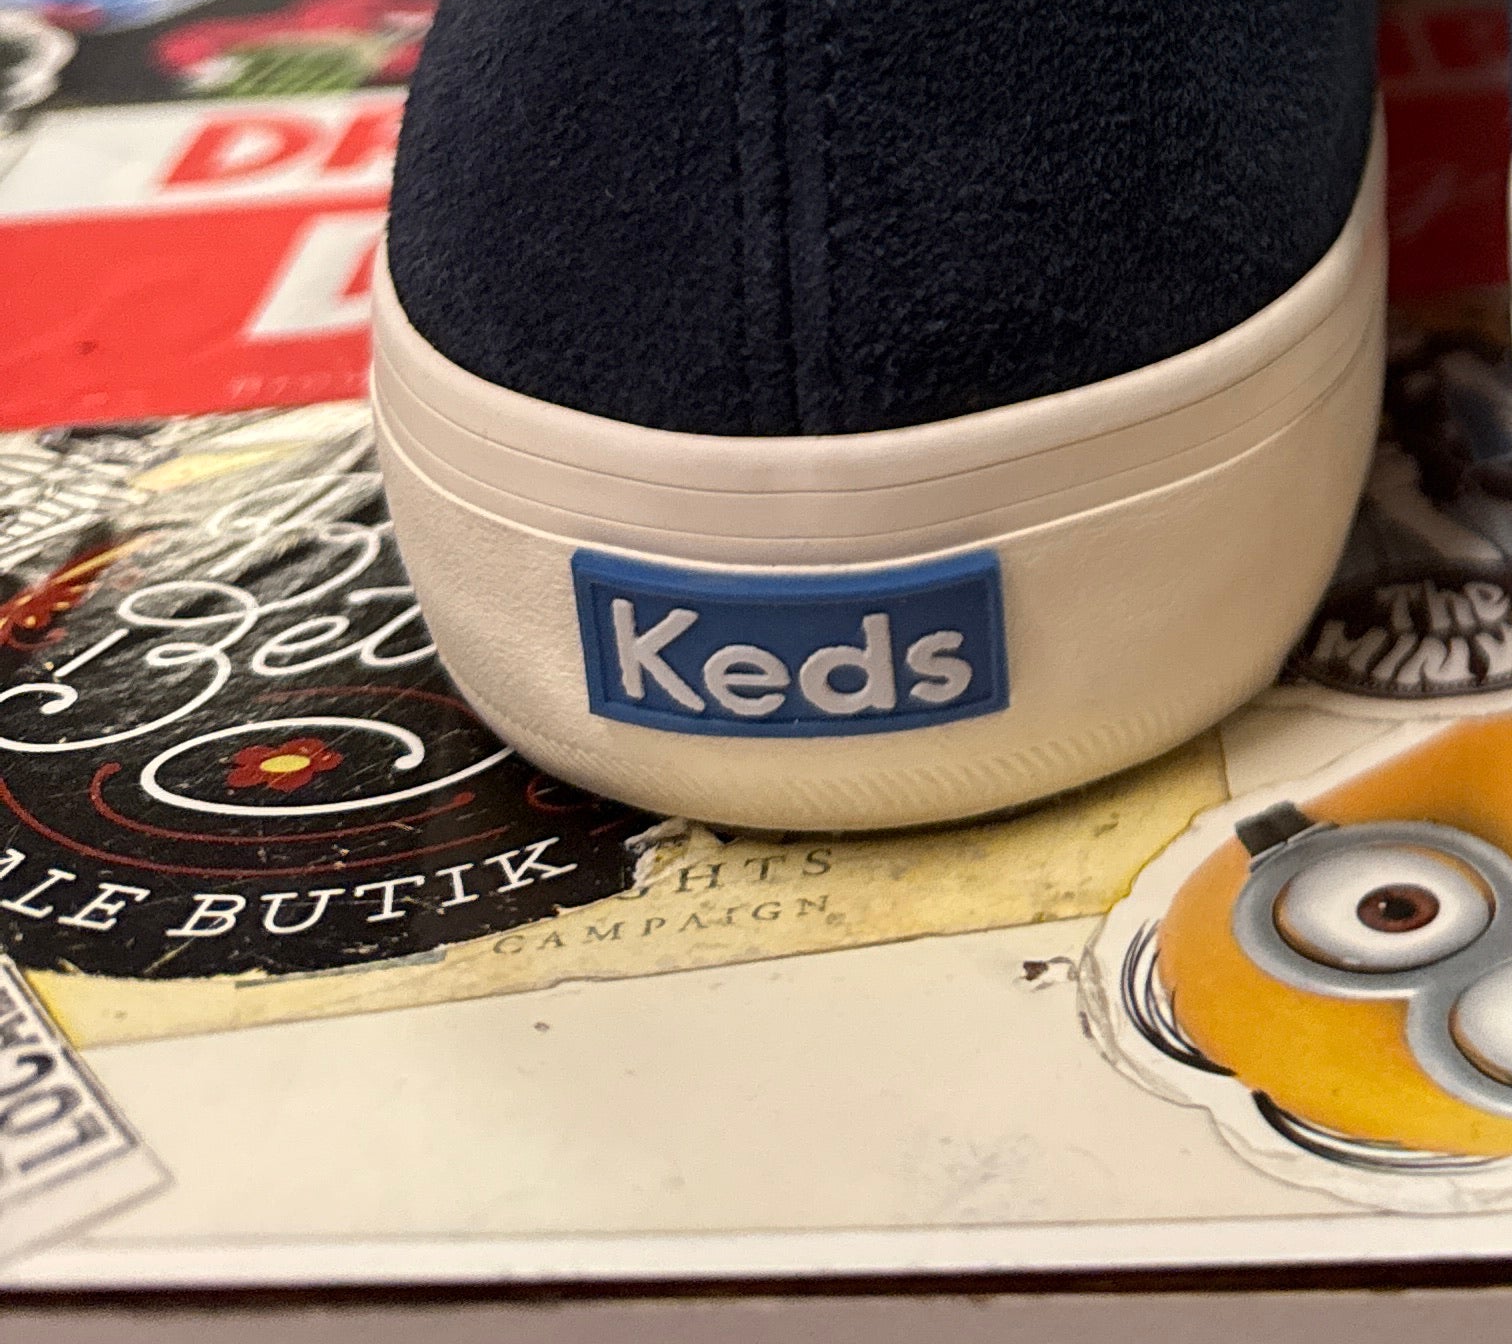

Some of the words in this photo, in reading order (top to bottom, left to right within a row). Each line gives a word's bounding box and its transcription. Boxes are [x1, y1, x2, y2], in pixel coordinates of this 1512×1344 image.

[611, 598, 973, 716] Keds
[166, 836, 577, 937] BUTIK
[617, 847, 832, 900] HTS
[493, 894, 830, 954] CAMPAIGN
